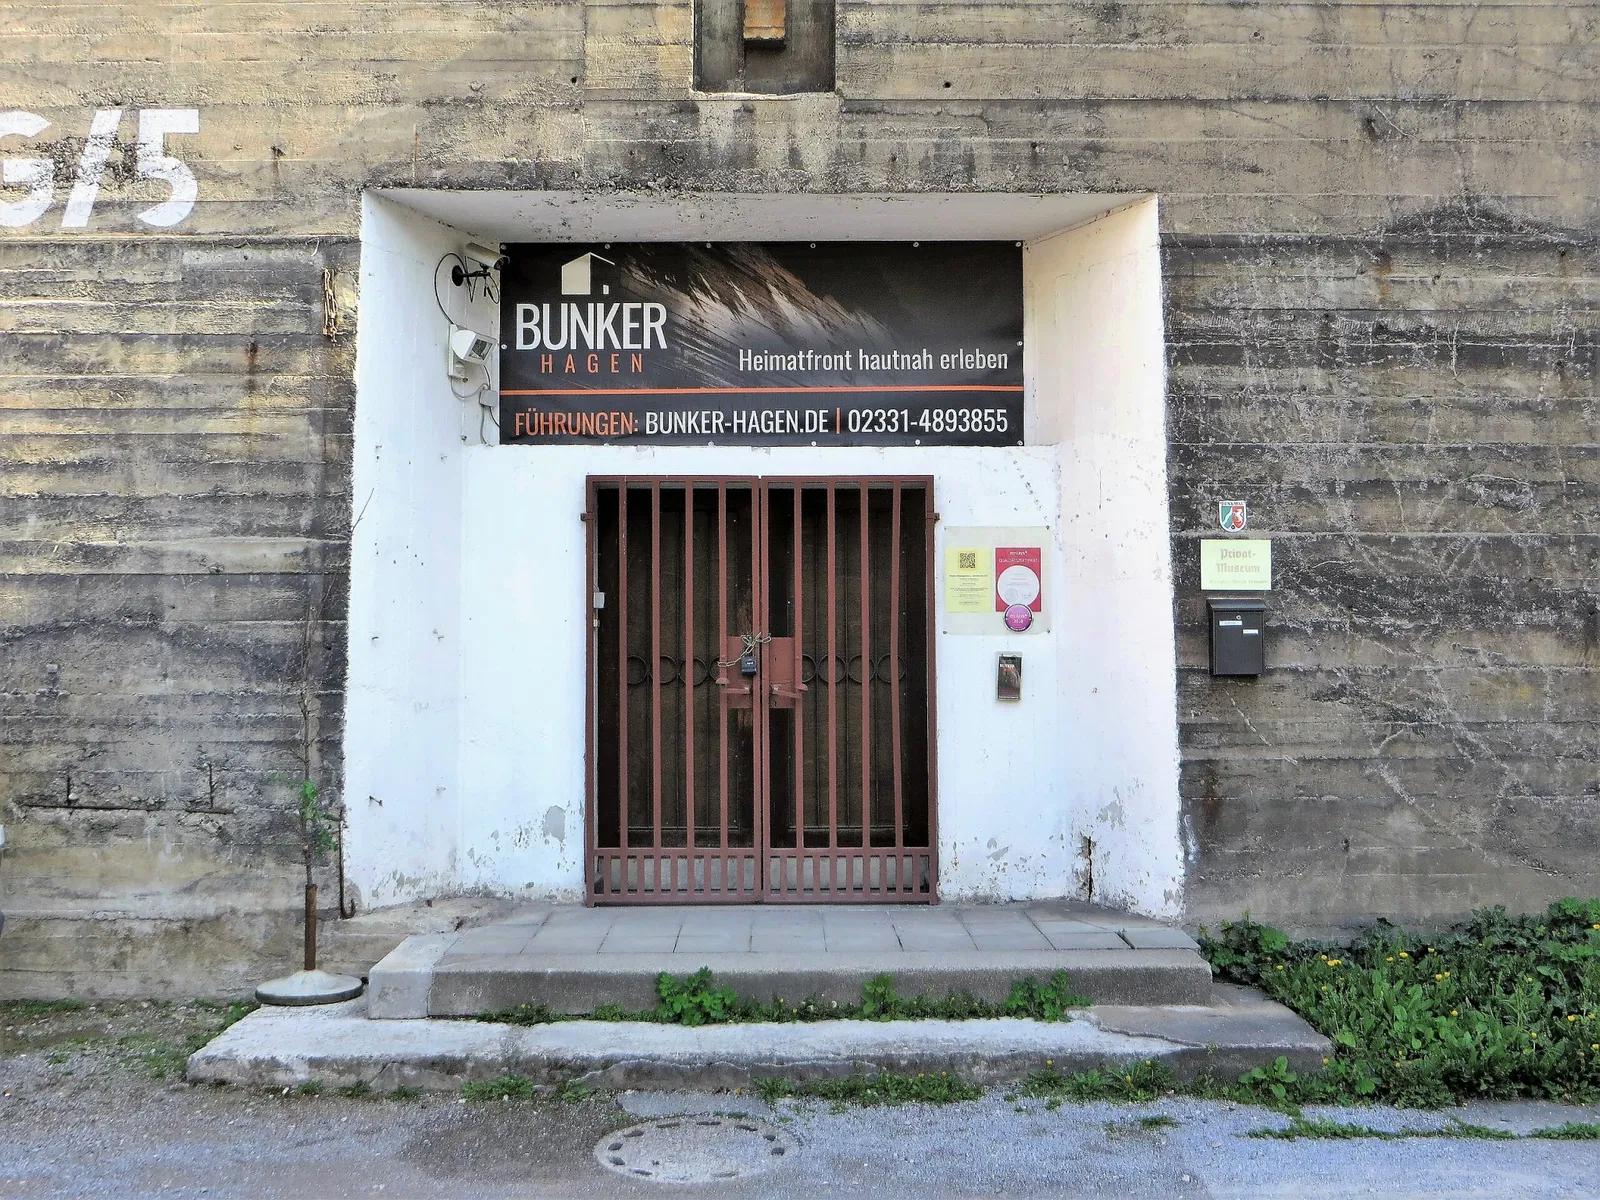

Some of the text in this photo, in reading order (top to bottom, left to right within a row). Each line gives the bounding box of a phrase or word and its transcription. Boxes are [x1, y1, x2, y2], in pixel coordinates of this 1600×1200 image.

[516, 302, 668, 351] BUNKER
[540, 353, 644, 375] HAGEN
[738, 347, 1009, 372] Heimatfront hautnah erleben
[514, 406, 1009, 437] FÜHRUNGEN: BUNKER-HAGEN.DE 02331-4893855
[1220, 548, 1256, 560] Privat-
[1215, 562, 1261, 574] Museum
